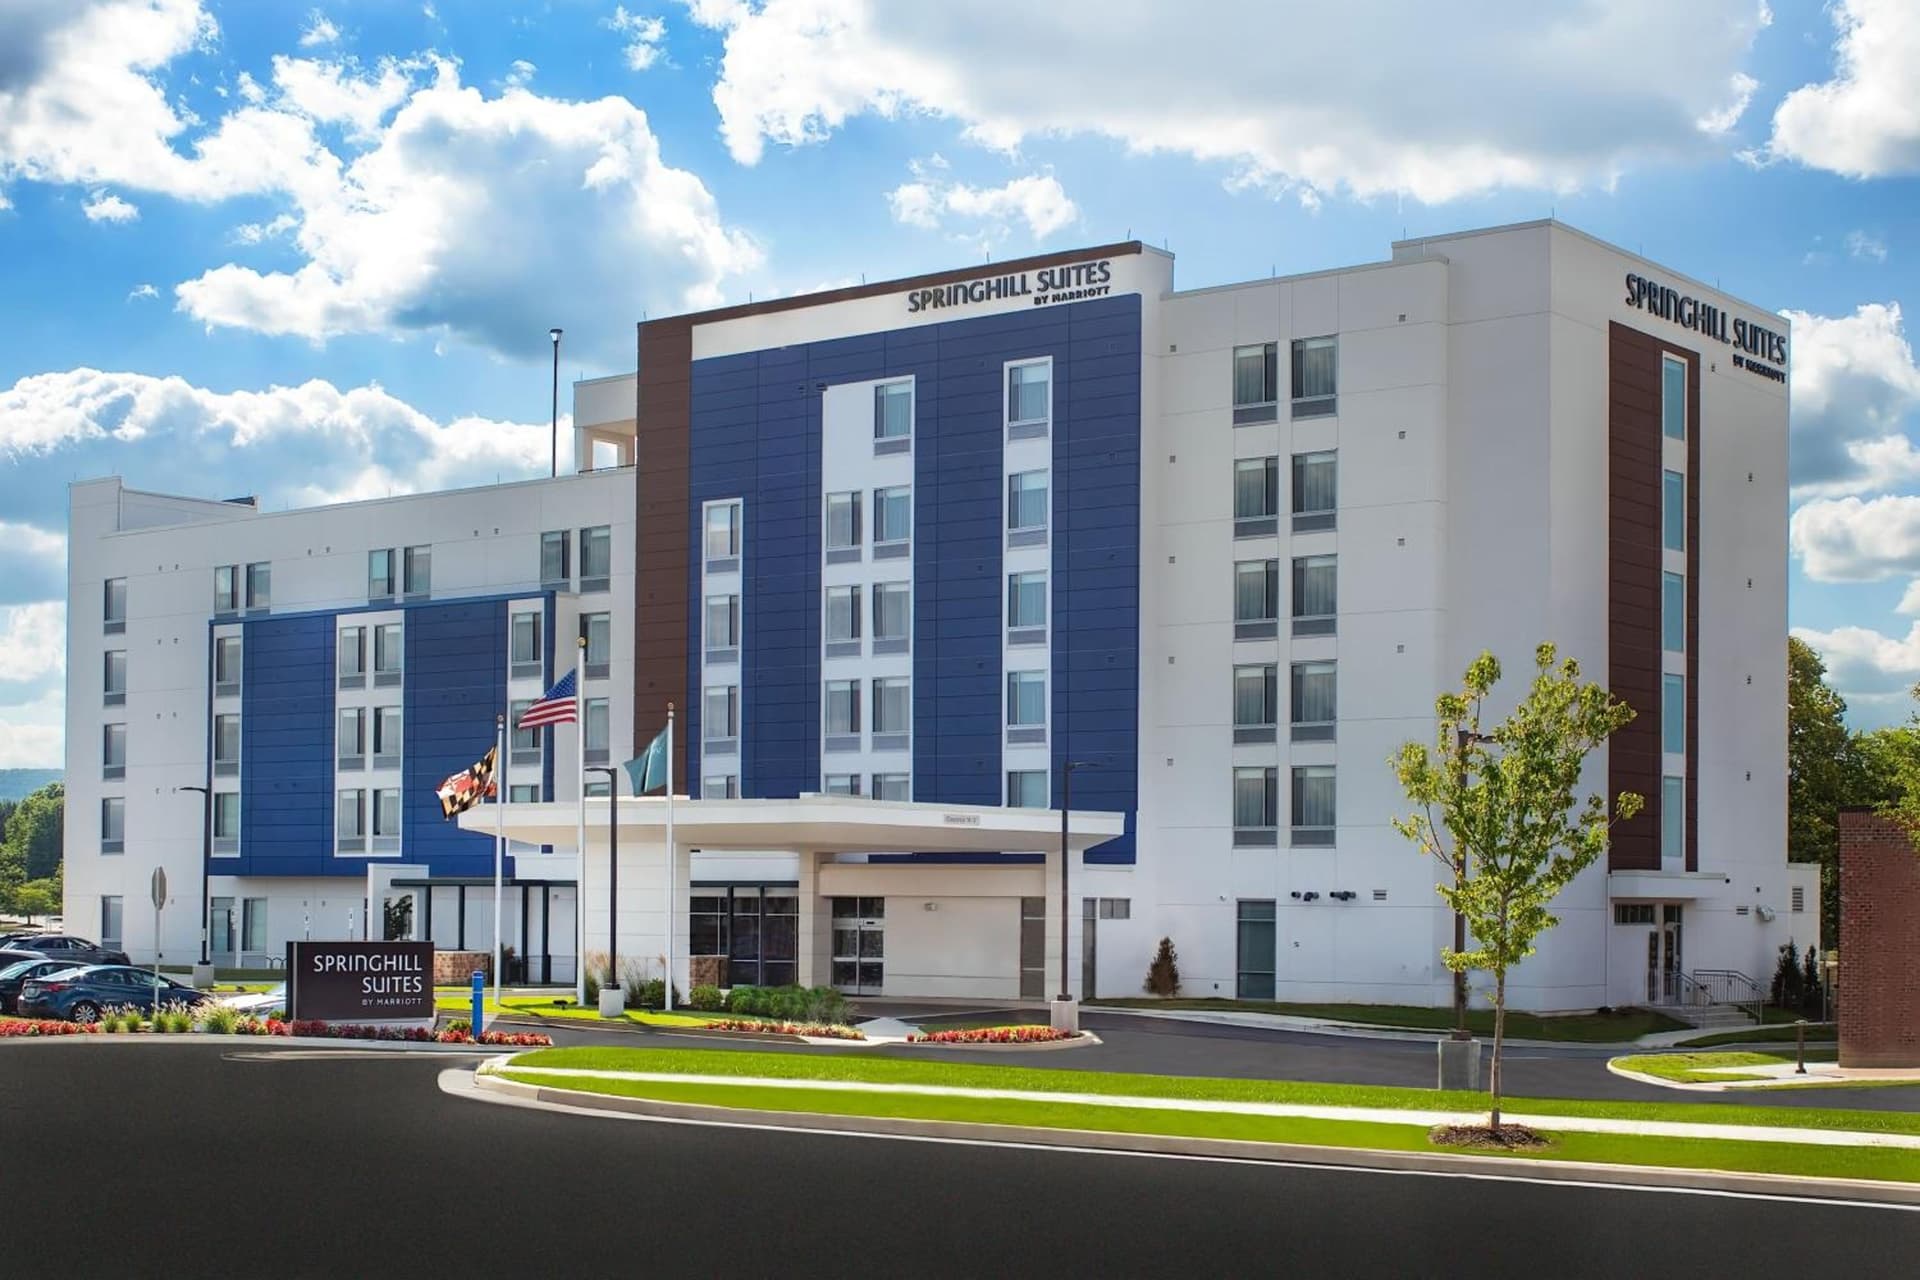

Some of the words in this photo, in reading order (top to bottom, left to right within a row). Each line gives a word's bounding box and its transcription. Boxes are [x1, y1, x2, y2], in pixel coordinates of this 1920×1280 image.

[908, 273, 1032, 313] SPRINGHILL
[1037, 261, 1111, 292] SUITES
[1034, 296, 1049, 305] BY
[1052, 285, 1111, 303] MARRIOTT
[1625, 273, 1731, 344] SPRINGHILL
[1733, 317, 1786, 365] SUITES
[313, 954, 423, 972] SPRINGHILL
[362, 976, 423, 993] SUITES
[362, 998, 373, 1006] BY
[377, 998, 422, 1006] MARRIOTT
